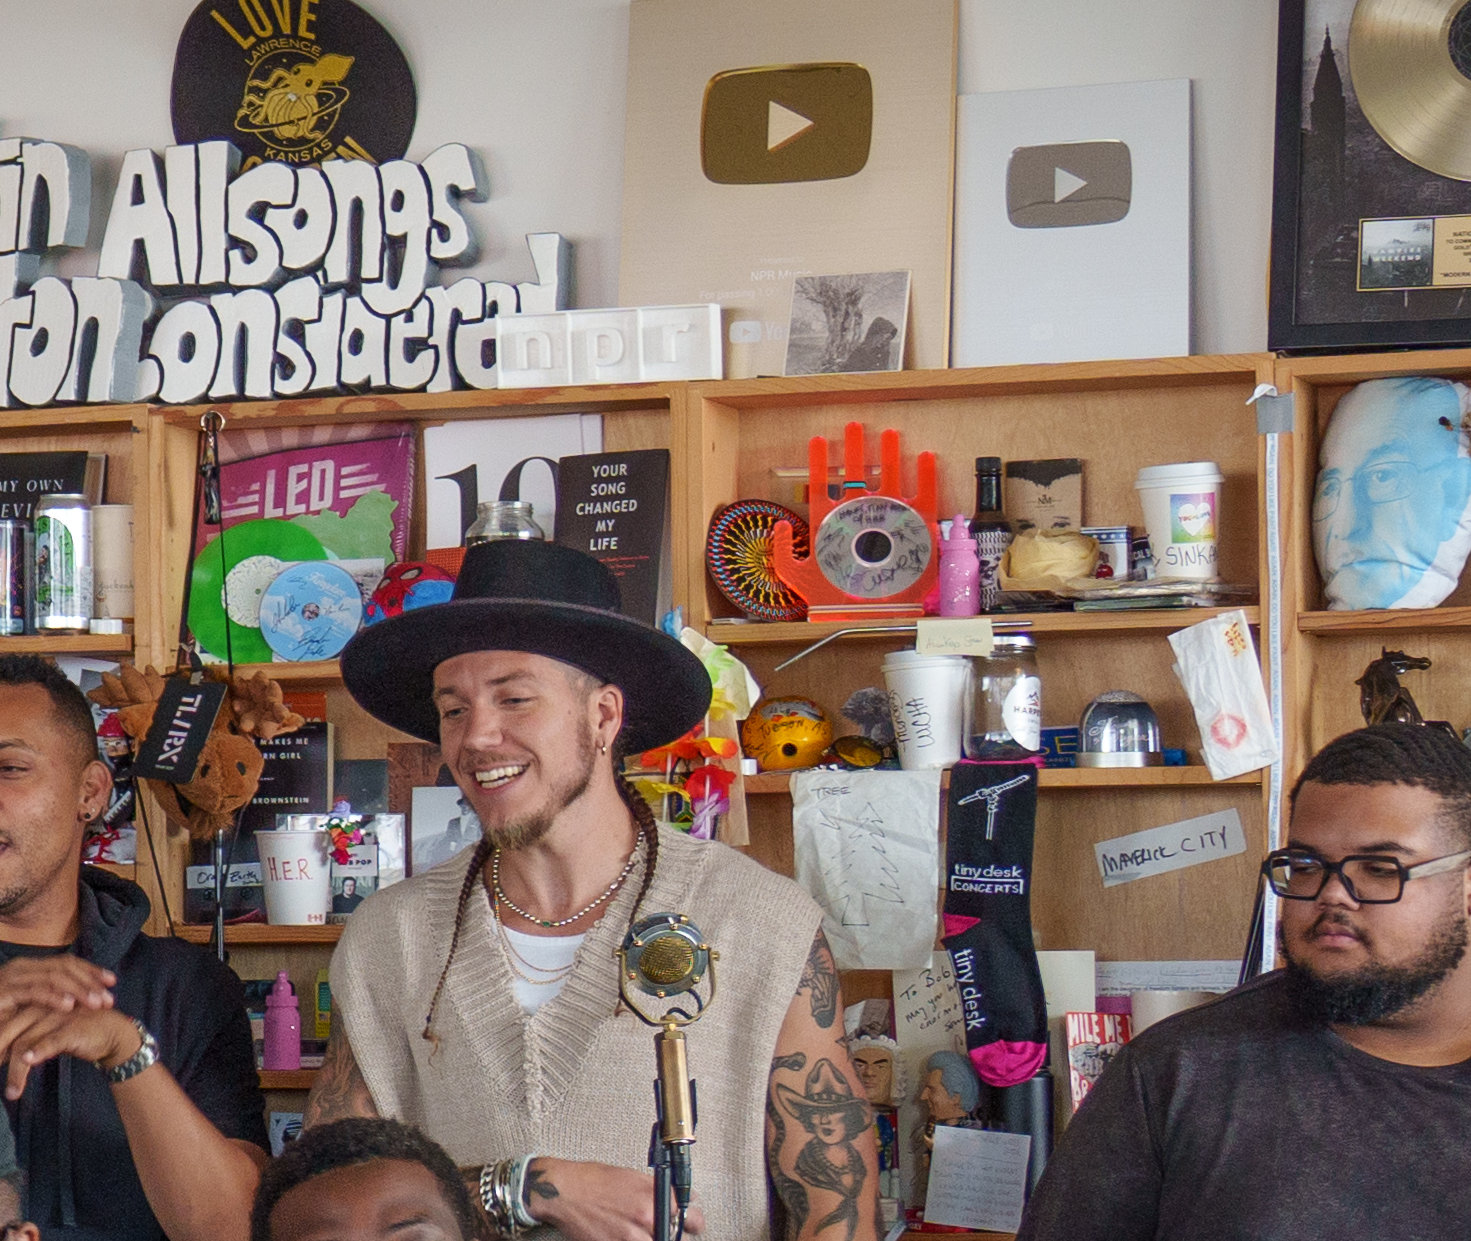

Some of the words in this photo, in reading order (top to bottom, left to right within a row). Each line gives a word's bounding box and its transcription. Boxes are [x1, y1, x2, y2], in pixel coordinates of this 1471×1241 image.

[210, 0, 320, 49] LOVE
[244, 38, 322, 66] LAWRENCE
[264, 138, 333, 163] KANSAS
[750, 271, 775, 281] NPR
[592, 464, 628, 478] YOUR
[26, 479, 64, 492] OWN
[263, 459, 336, 520] LED
[590, 482, 626, 496] SONG
[576, 500, 638, 515] CHANGED
[595, 519, 615, 533] MY
[589, 537, 618, 551] LIFE
[260, 738, 292, 746] MAKES
[296, 737, 309, 745] ME
[279, 752, 302, 760] GIRL
[812, 786, 852, 799] TREE
[252, 797, 309, 805] BROWNSTEIN
[1102, 844, 1175, 880] MAVERICK
[1181, 825, 1229, 853] CITY
[267, 857, 313, 881] H.E.R.
[954, 864, 981, 879] tiny
[983, 864, 1022, 878] desk
[953, 880, 1020, 894] CONCERTS
[954, 949, 975, 985] tiny
[919, 966, 952, 989] Bob
[963, 986, 986, 1031] desk
[1068, 1014, 1100, 1046] MILE
